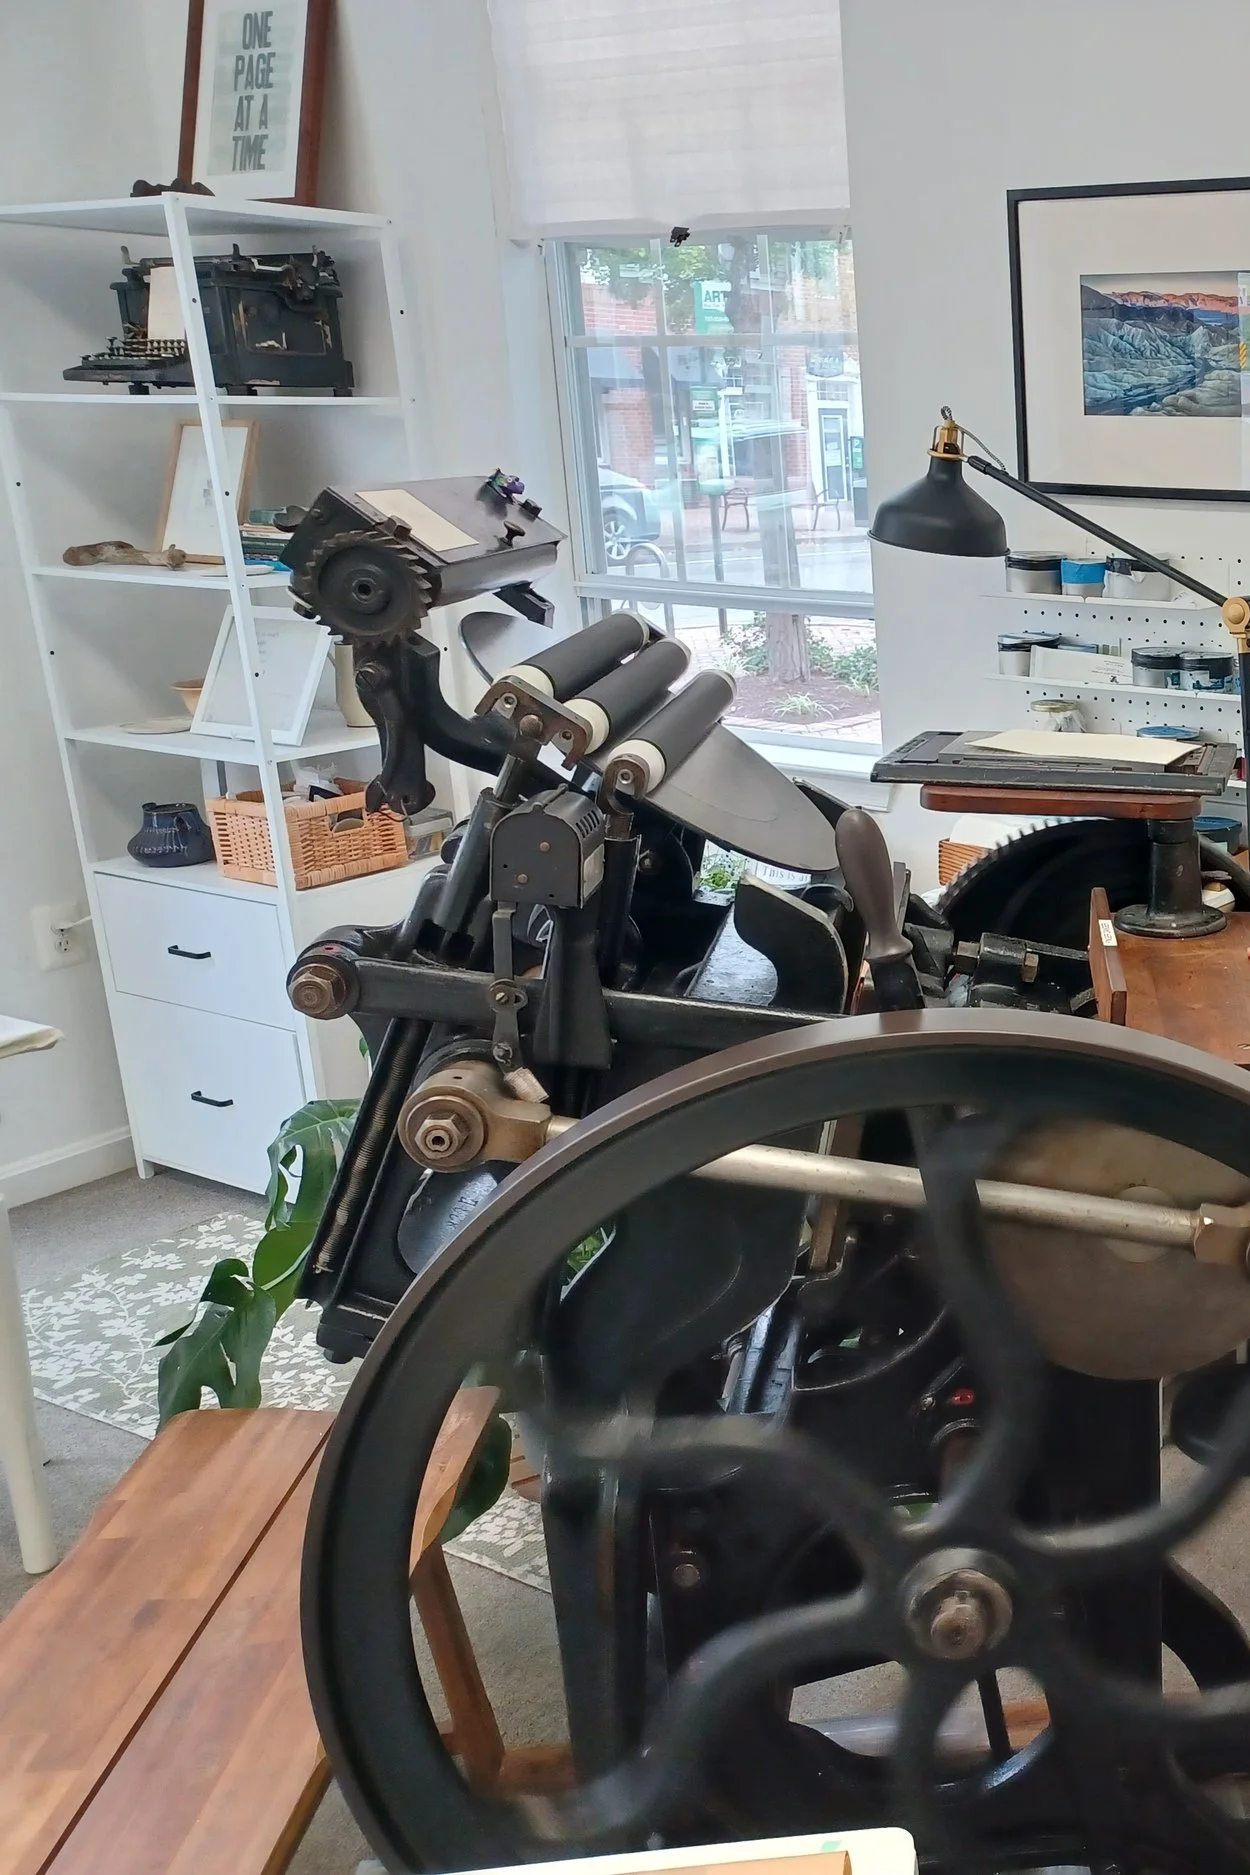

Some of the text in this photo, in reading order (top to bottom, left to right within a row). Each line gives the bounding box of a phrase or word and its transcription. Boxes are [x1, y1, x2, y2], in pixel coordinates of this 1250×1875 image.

[242, 11, 273, 50] ONE
[234, 52, 276, 91] PAGE
[234, 94, 268, 132] AT A
[232, 134, 269, 171] TIME
